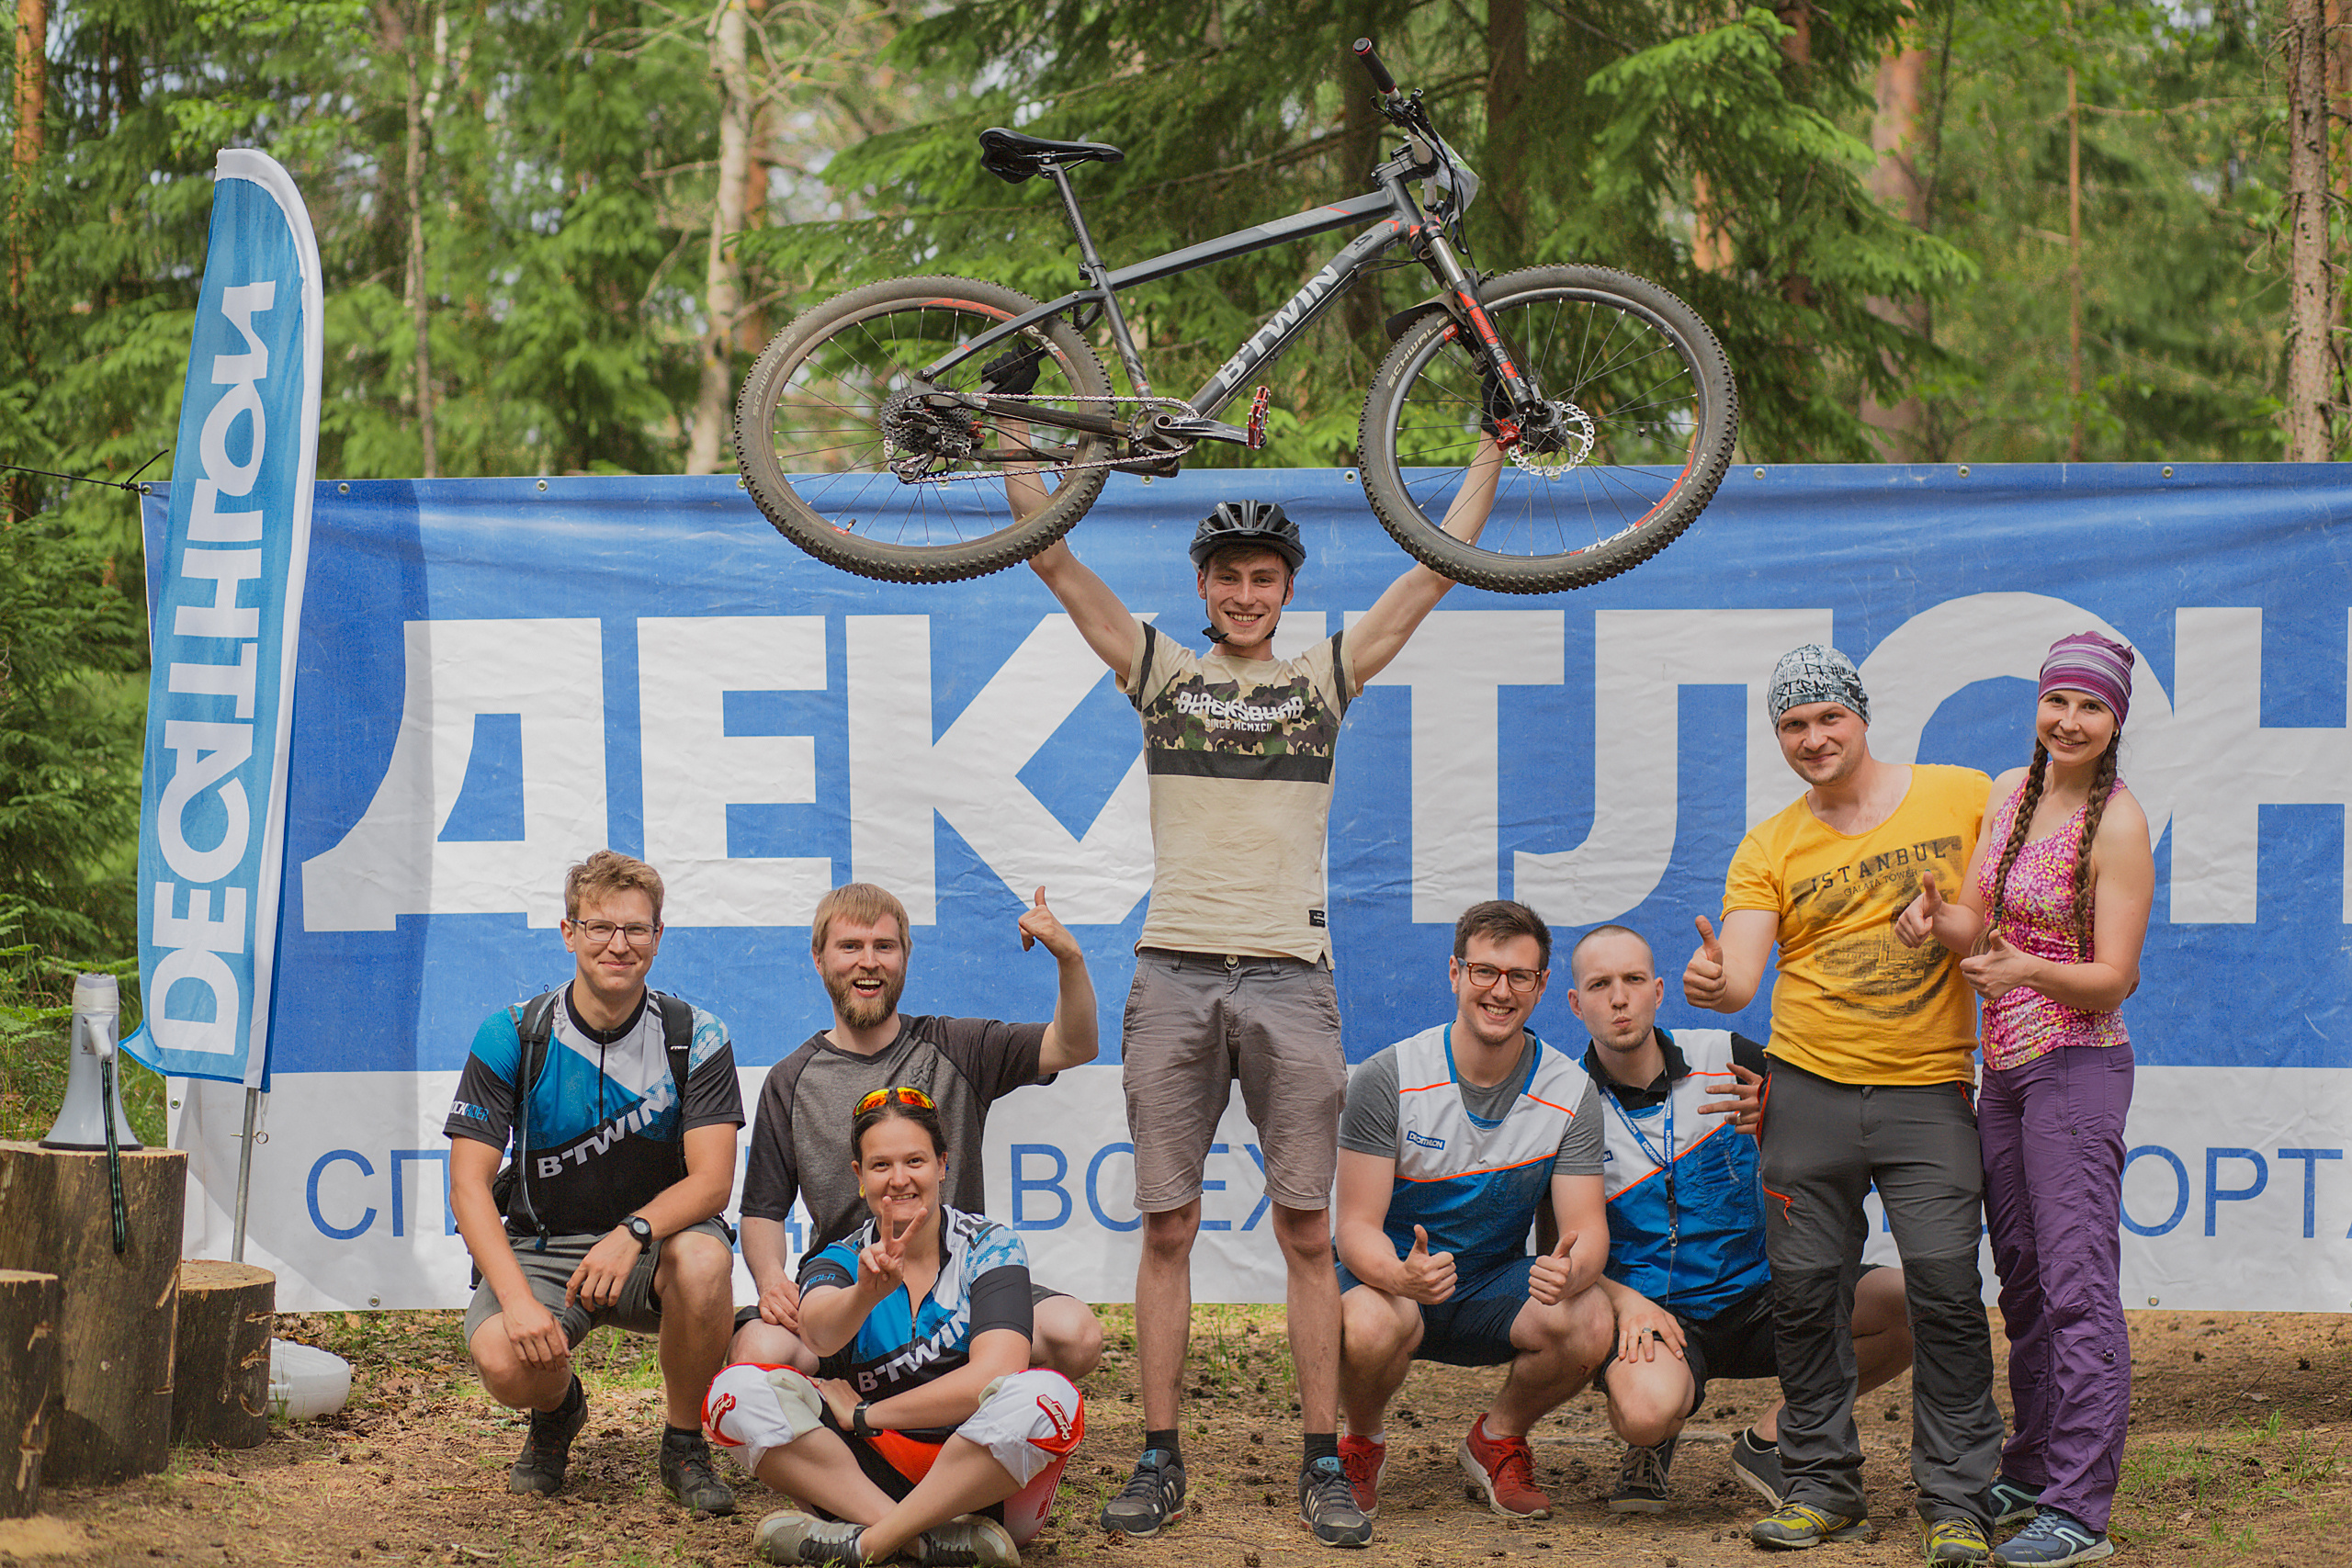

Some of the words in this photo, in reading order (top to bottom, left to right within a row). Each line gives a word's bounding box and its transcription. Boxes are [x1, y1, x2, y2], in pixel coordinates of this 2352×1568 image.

[1387, 315, 1449, 389] SCHWALB
[752, 333, 797, 418] SCHWALBE
[150, 279, 277, 1056] DECATHLON
[1205, 719, 1231, 730] SINCE
[1812, 840, 1947, 893] ISTANBUL
[1843, 879, 1882, 897] GALATA
[1883, 869, 1917, 887] TOWER
[1408, 1132, 1444, 1149] DECATHLON
[1617, 1106, 1639, 1135] DECATHLON
